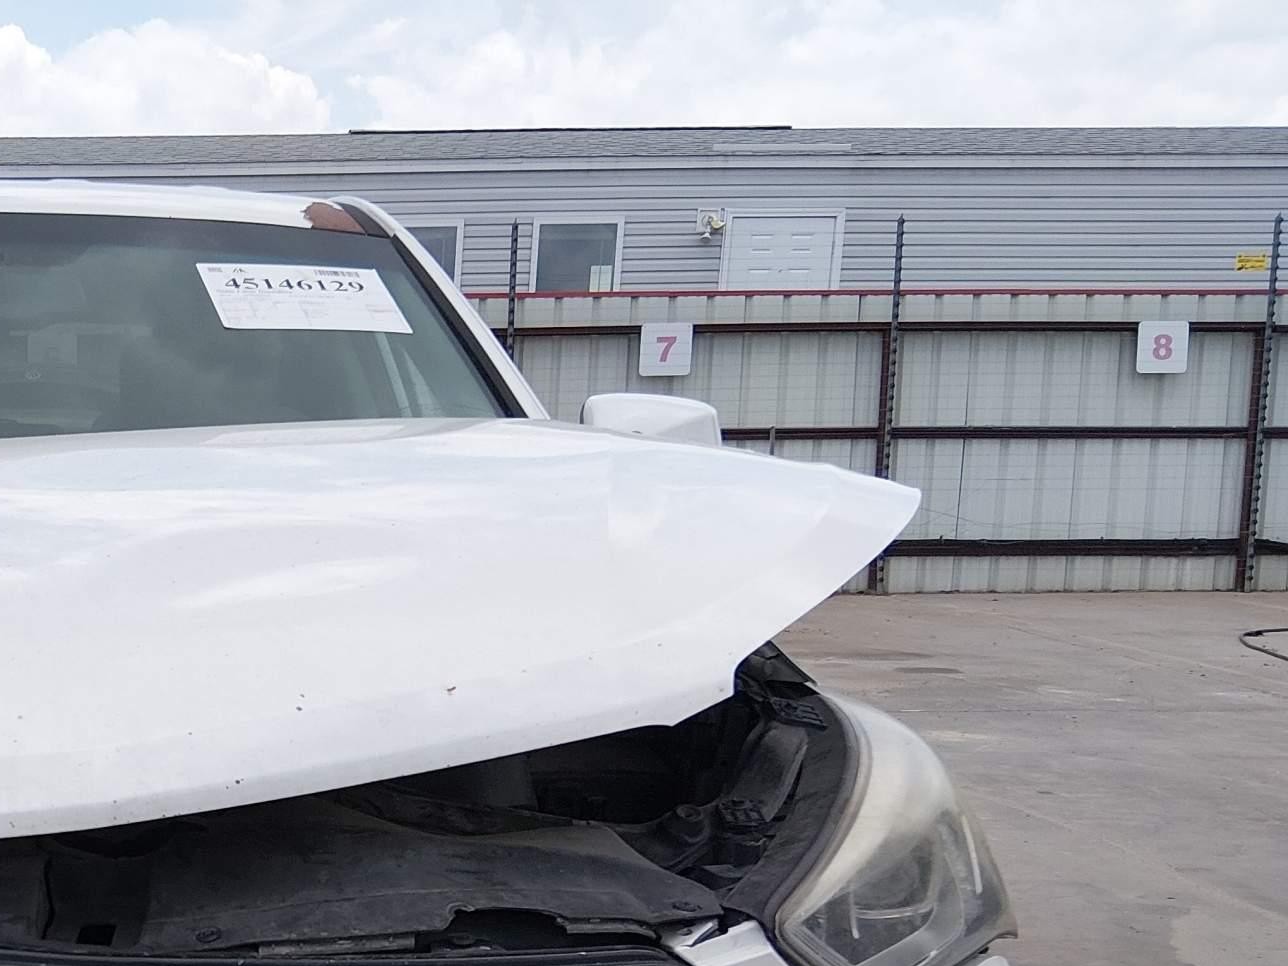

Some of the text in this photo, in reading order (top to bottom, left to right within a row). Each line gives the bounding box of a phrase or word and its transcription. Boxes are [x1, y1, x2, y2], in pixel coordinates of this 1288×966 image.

[224, 277, 365, 293] 45146129
[656, 336, 677, 363] 7
[1152, 334, 1173, 361] 8
